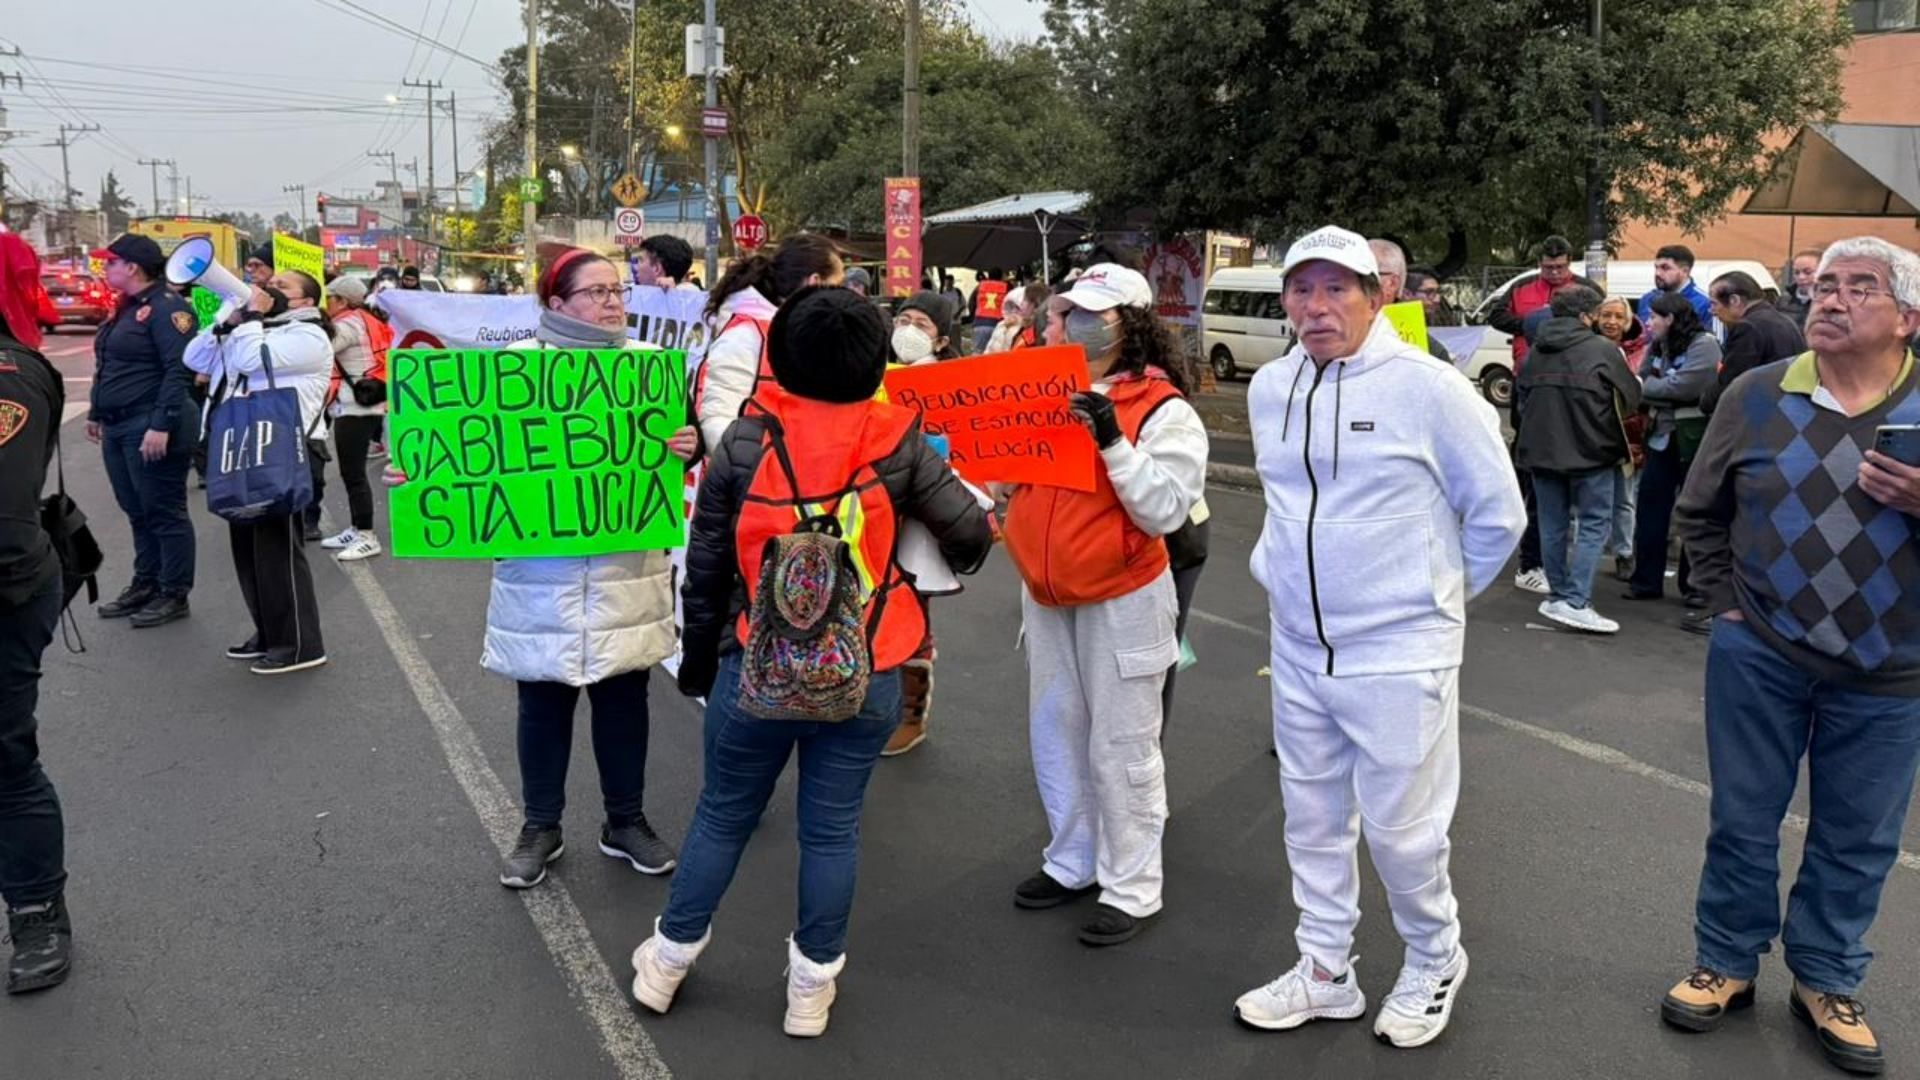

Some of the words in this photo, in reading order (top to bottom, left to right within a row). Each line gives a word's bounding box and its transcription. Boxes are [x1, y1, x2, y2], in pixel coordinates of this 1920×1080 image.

[623, 215, 637, 224] 20
[735, 224, 765, 243] ALTO
[391, 350, 687, 415] REUBICACION
[897, 373, 1078, 416] REUBICACIÓN
[923, 418, 961, 435] DE
[970, 404, 1084, 432] ESTACIÓN
[220, 420, 273, 475] GAP
[397, 407, 669, 482] CABLEBUS
[974, 438, 1055, 462] LUCÍA
[418, 480, 539, 548] STA.
[546, 470, 678, 538] LUCIA
